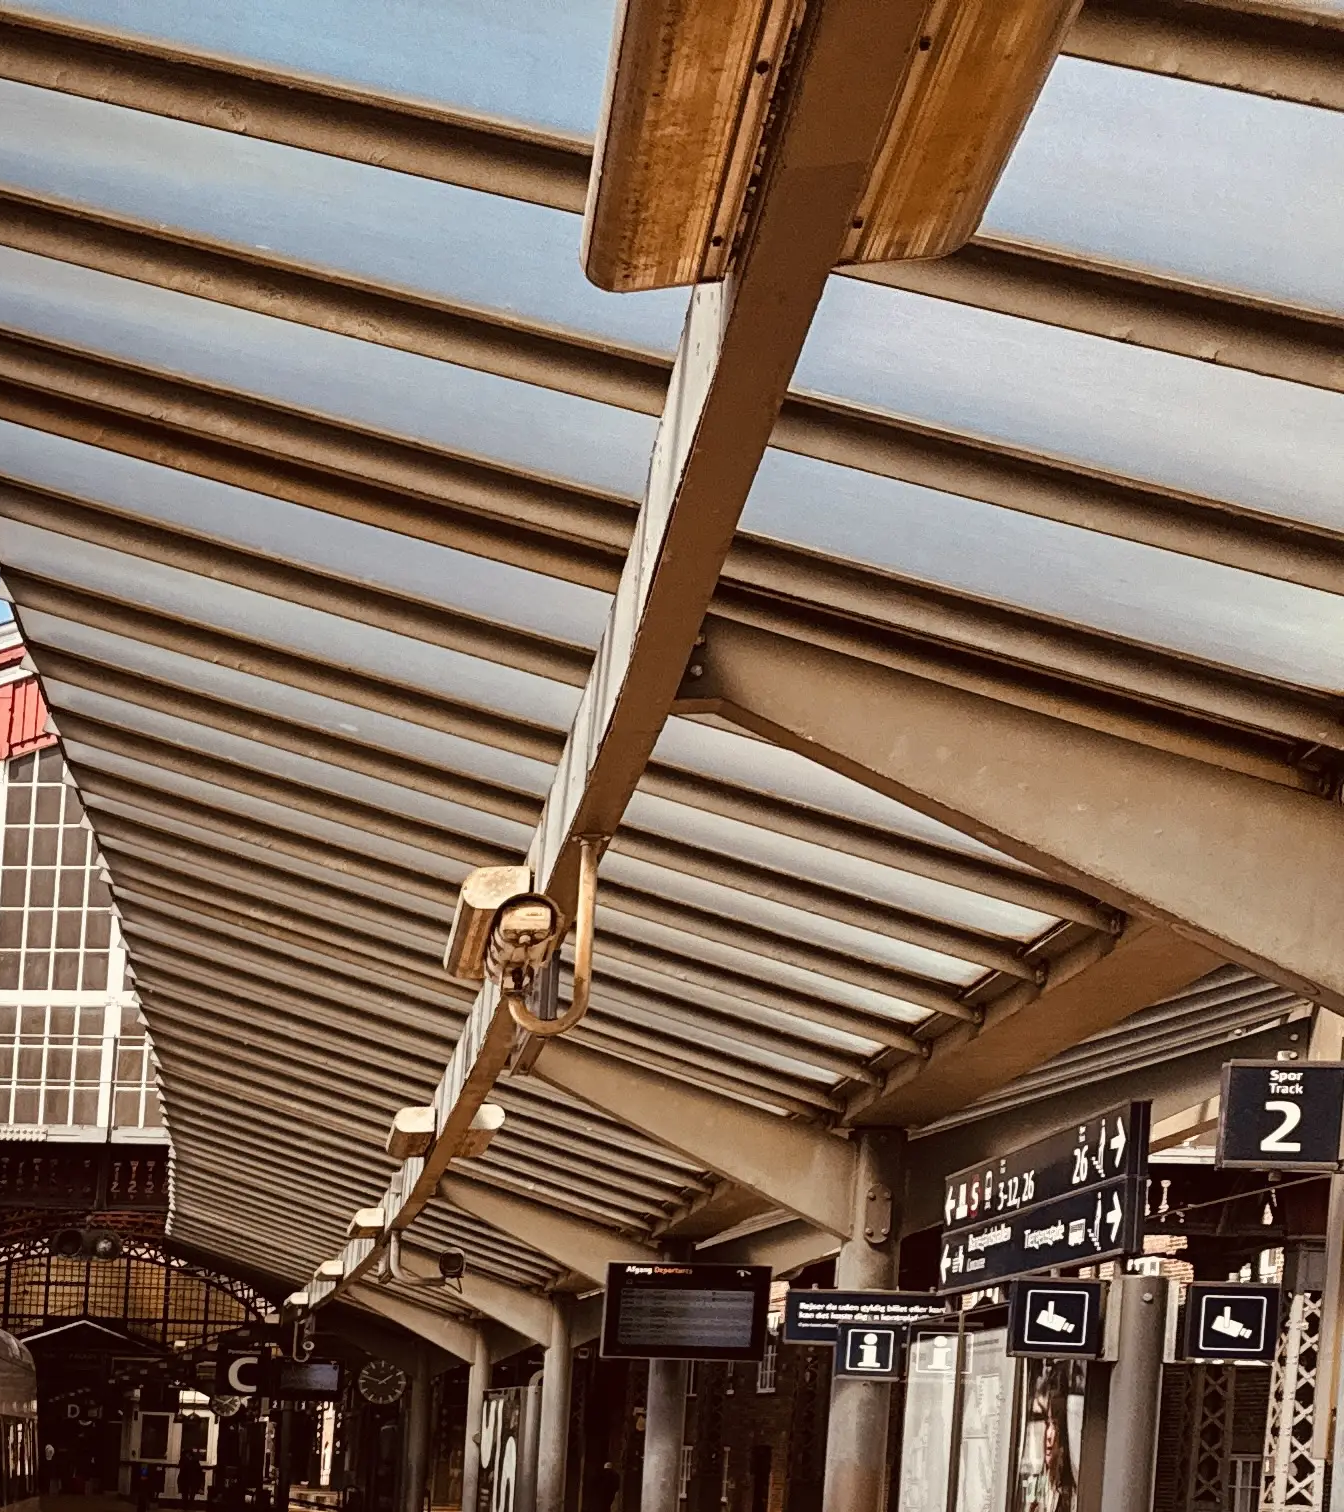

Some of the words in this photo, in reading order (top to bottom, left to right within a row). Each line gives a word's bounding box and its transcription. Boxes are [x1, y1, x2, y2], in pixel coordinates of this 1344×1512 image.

[1268, 1083, 1304, 1094] Track
[1269, 1069, 1304, 1082] Spor
[1260, 1101, 1301, 1152] 2
[1072, 1145, 1088, 1184] 26
[1021, 1170, 1035, 1202] 26
[228, 1356, 258, 1393] C
[67, 1404, 80, 1418] D
